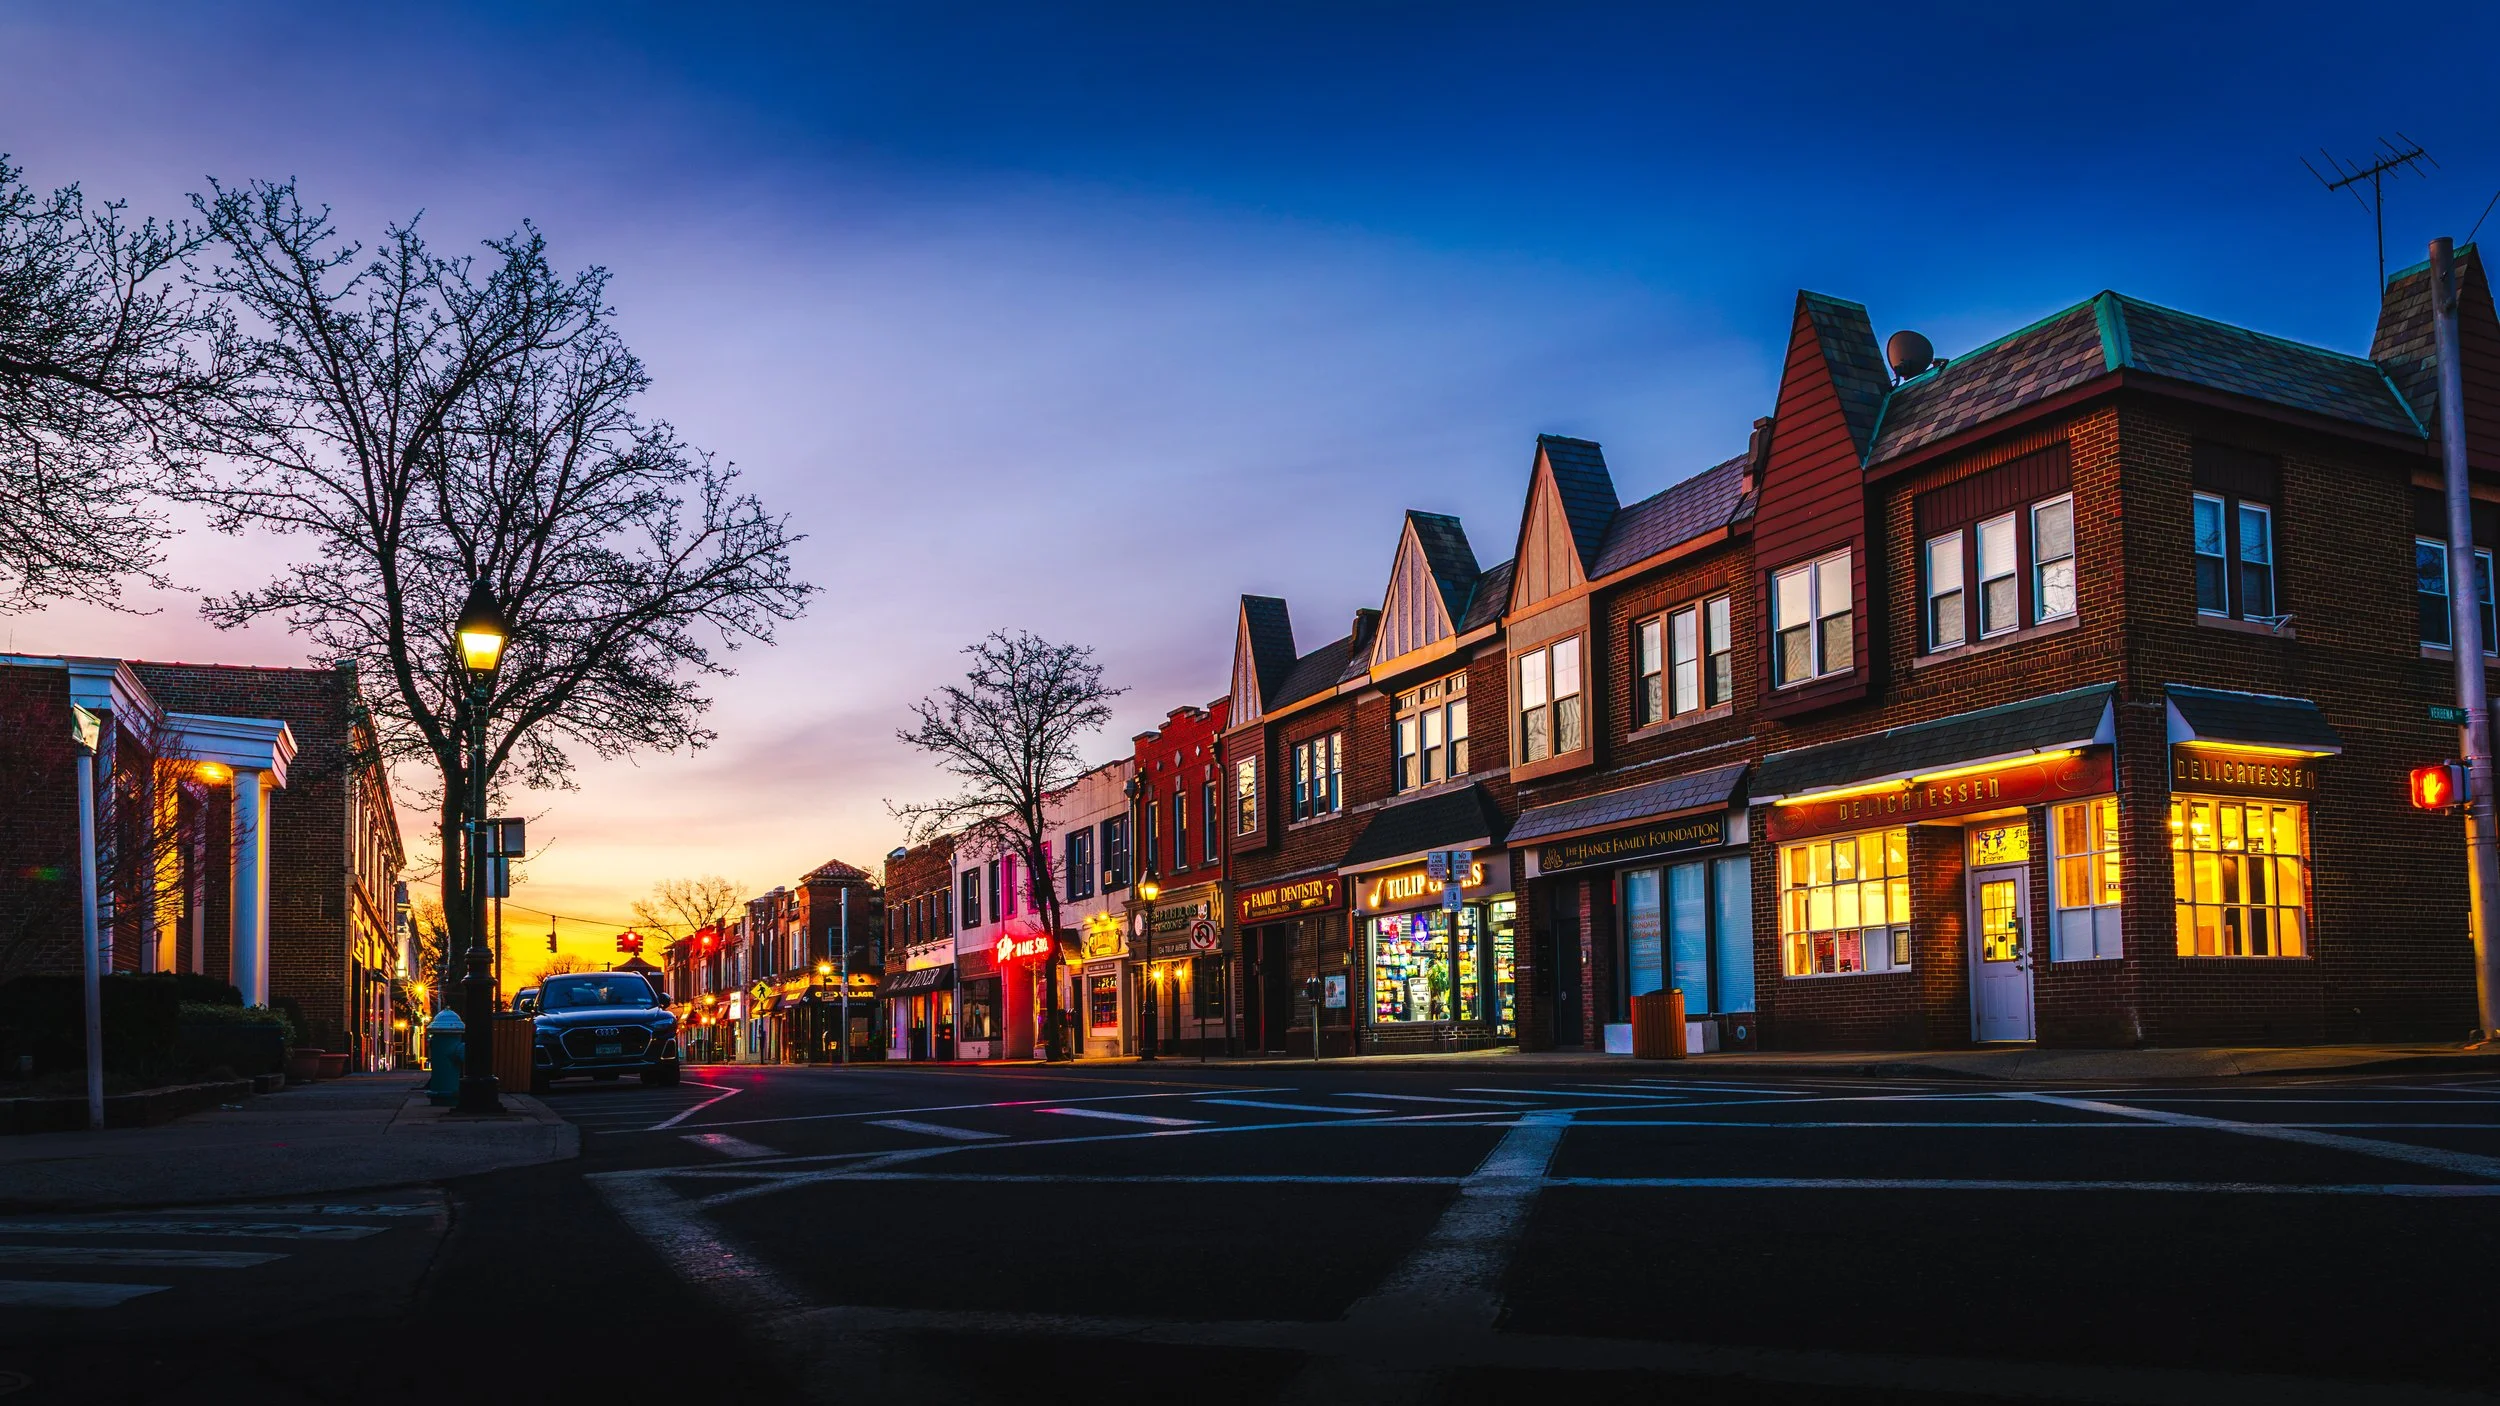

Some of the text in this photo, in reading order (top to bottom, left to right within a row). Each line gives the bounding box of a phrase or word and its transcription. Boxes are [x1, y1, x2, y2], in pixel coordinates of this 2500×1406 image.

[2430, 707, 2454, 720] VERBENA
[2176, 757, 2316, 790] DELICATESSEN
[1839, 776, 2000, 821] DELICATESSEN
[1579, 841, 1611, 859] HANCE
[1613, 832, 1647, 854] FAMILY
[1649, 821, 1719, 847] FOUNDATION
[1252, 888, 1278, 908] FAMILY
[1281, 880, 1324, 903] DENTISTRY
[1388, 874, 1425, 899] TULIP
[909, 967, 940, 988] DINER
